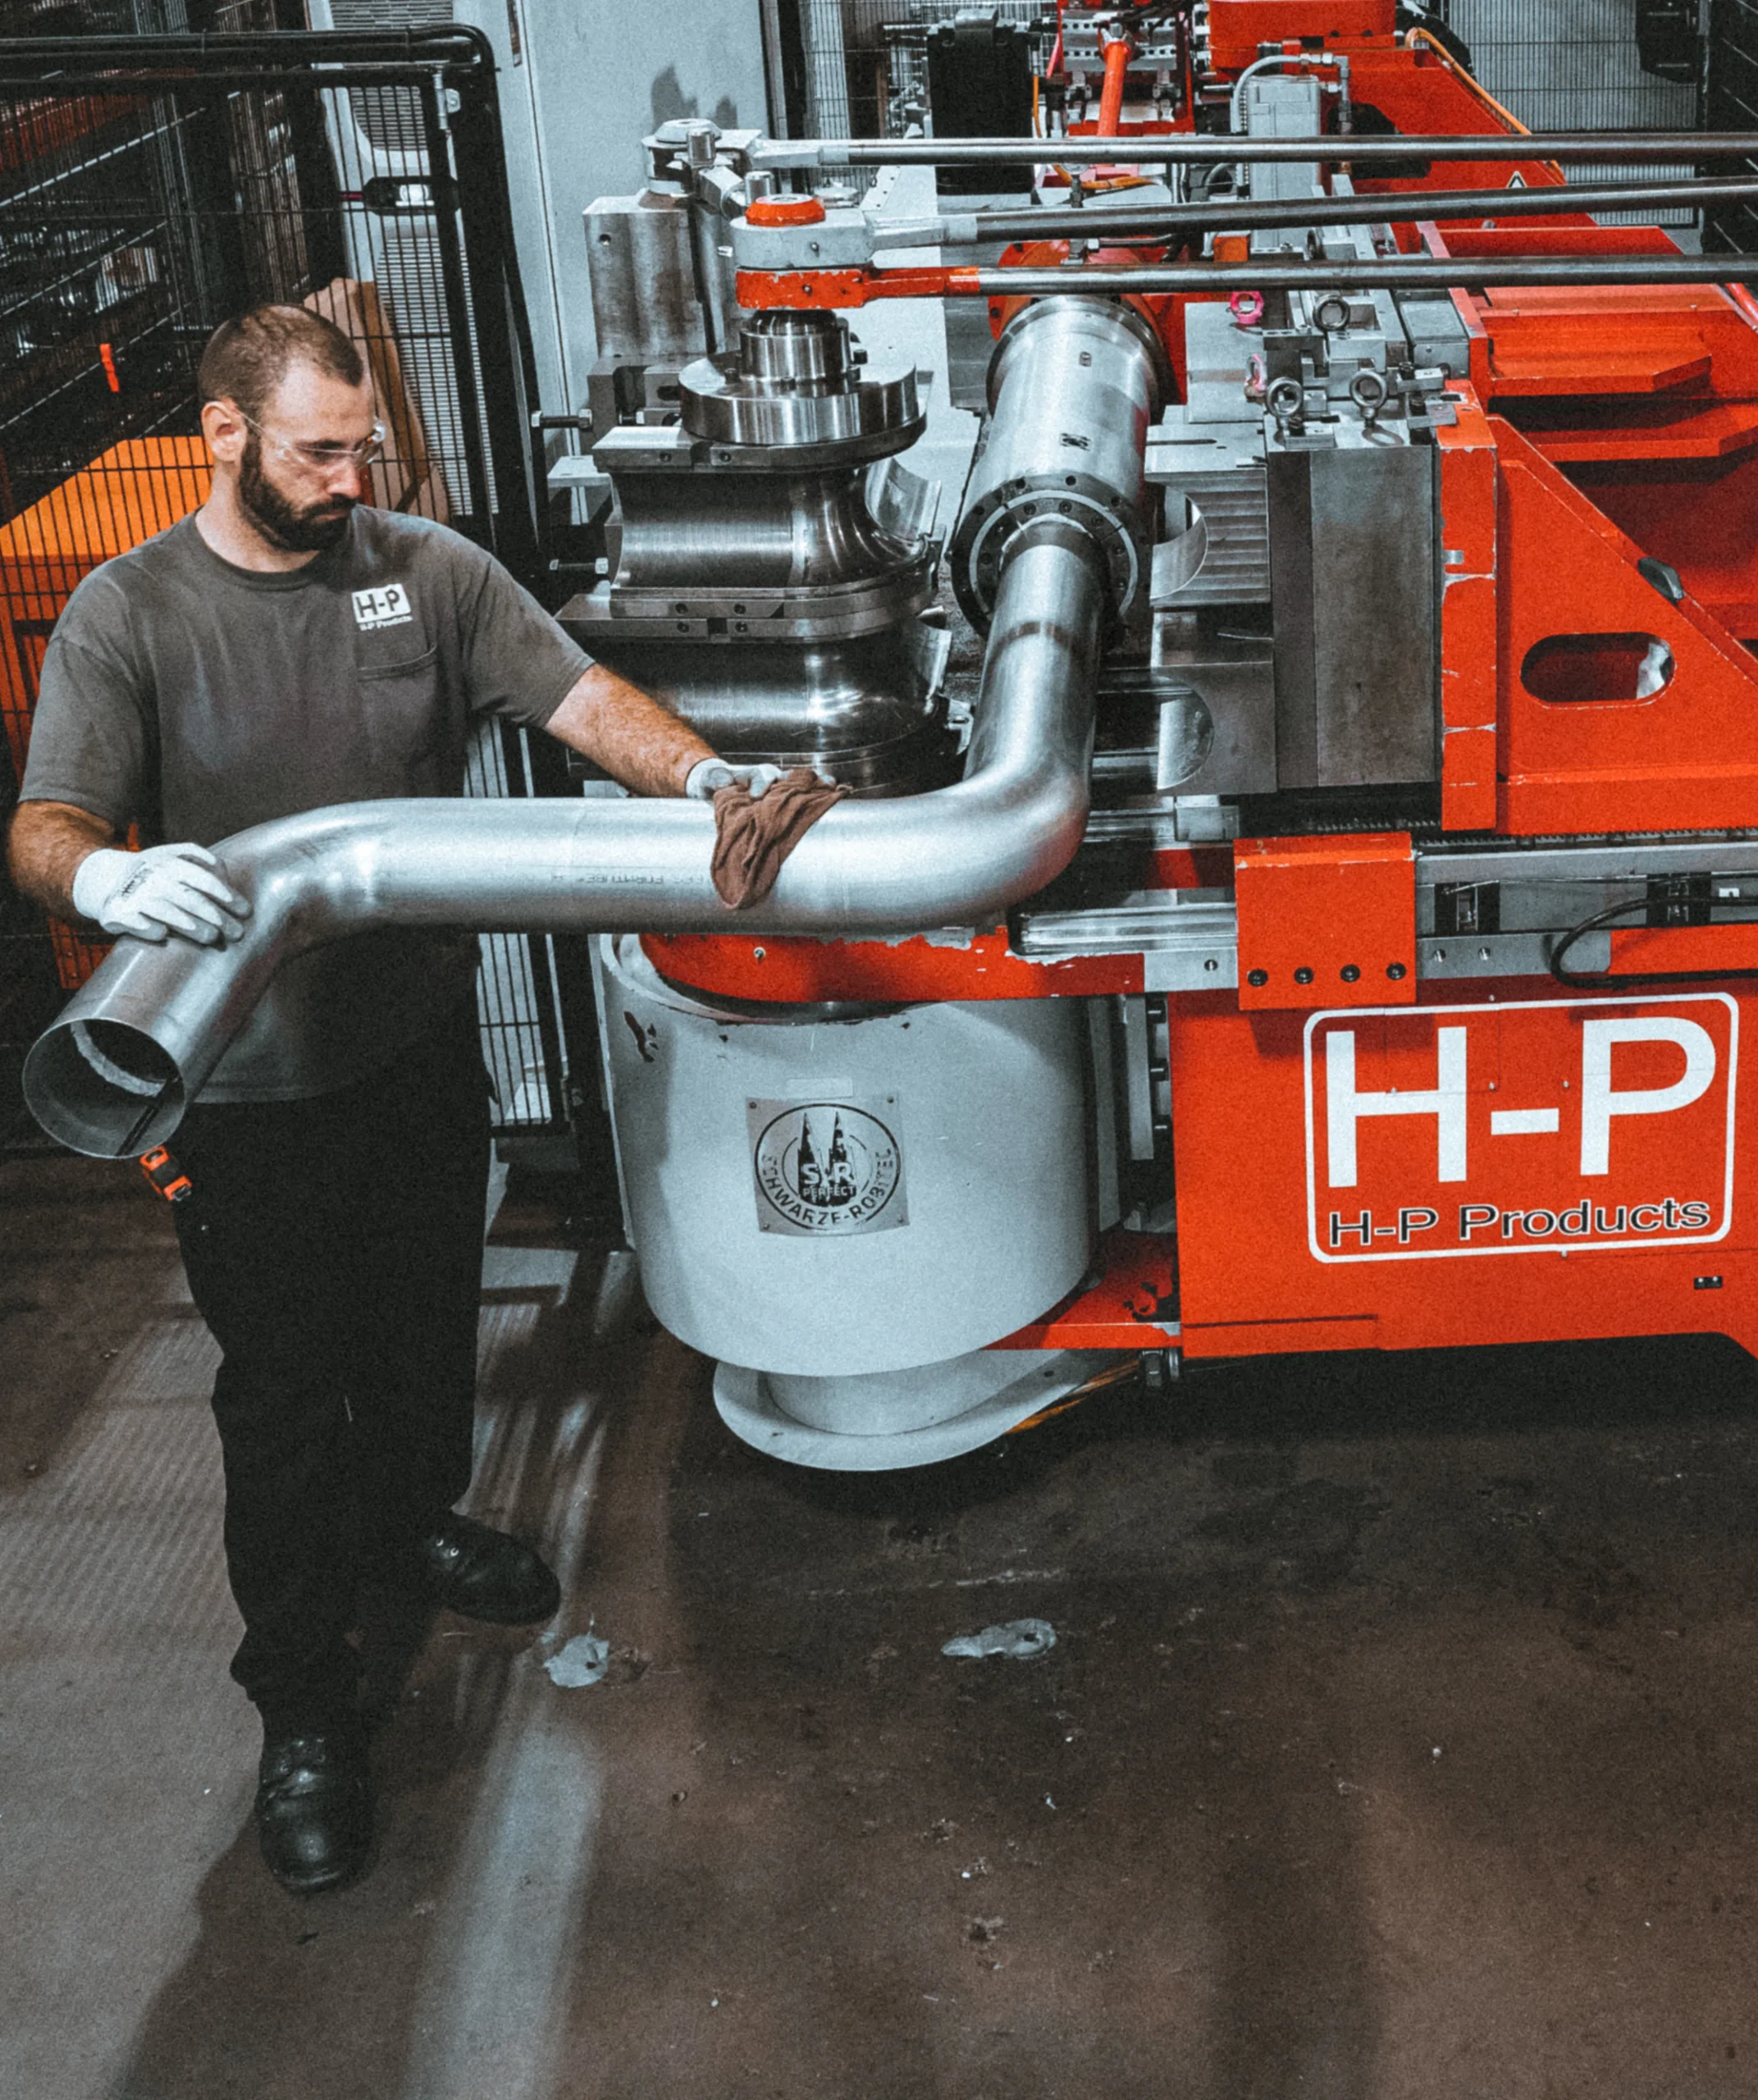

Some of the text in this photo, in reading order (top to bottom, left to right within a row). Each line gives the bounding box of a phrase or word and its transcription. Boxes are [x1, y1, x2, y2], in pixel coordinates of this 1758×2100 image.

[354, 589, 400, 619] H-P
[1326, 1016, 1716, 1188] H-P
[1329, 1198, 1711, 1248] H-P Products
